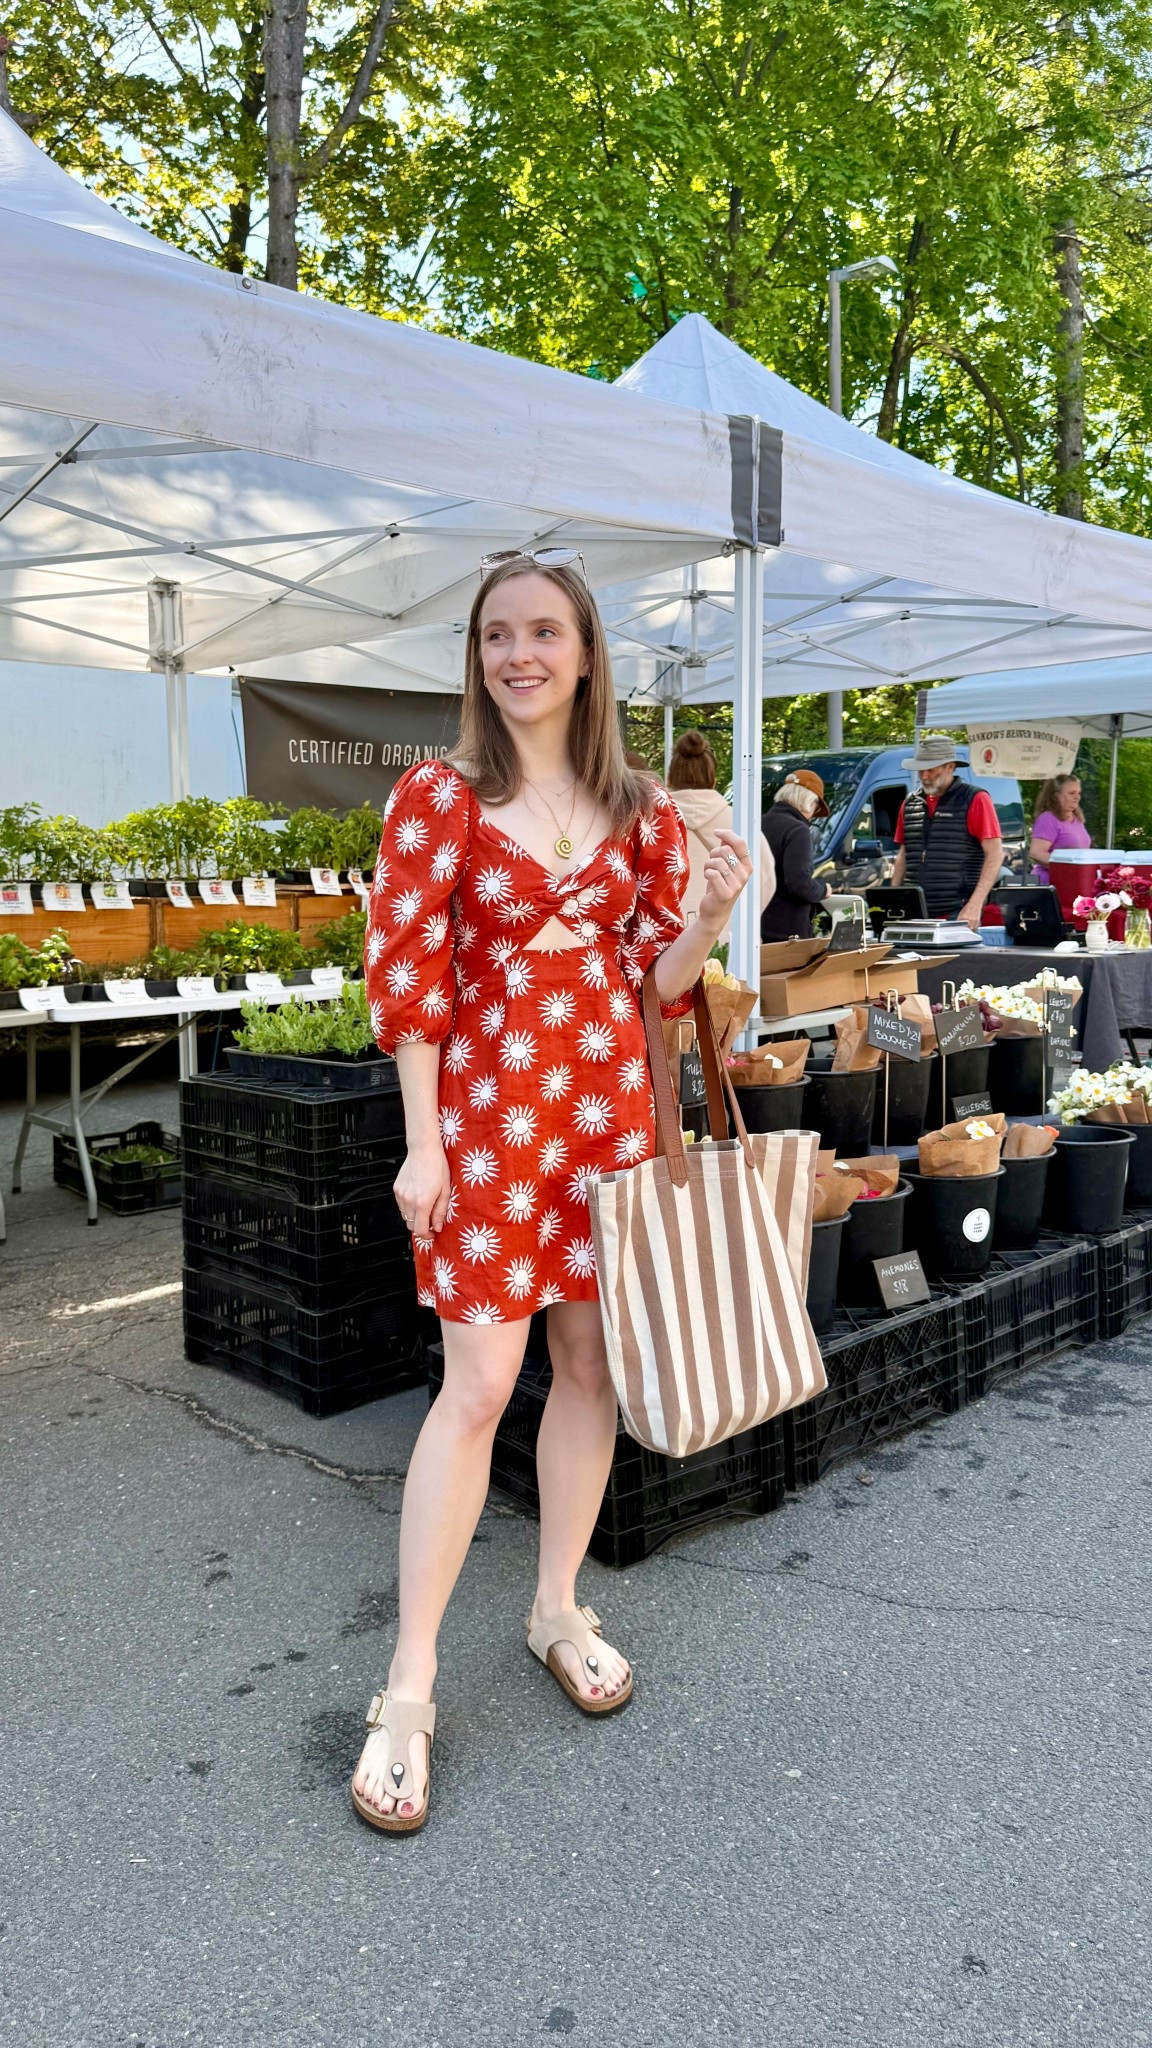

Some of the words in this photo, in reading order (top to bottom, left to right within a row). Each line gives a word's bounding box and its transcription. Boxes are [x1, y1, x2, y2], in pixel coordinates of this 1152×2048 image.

[288, 739, 374, 765] CERTIFIED
[873, 1014, 906, 1033] MIXED
[873, 1029, 914, 1051] BOUQUET
[957, 1034, 977, 1047] $20
[685, 1063, 703, 1076] TULI
[881, 1259, 919, 1278] ANEMONES
